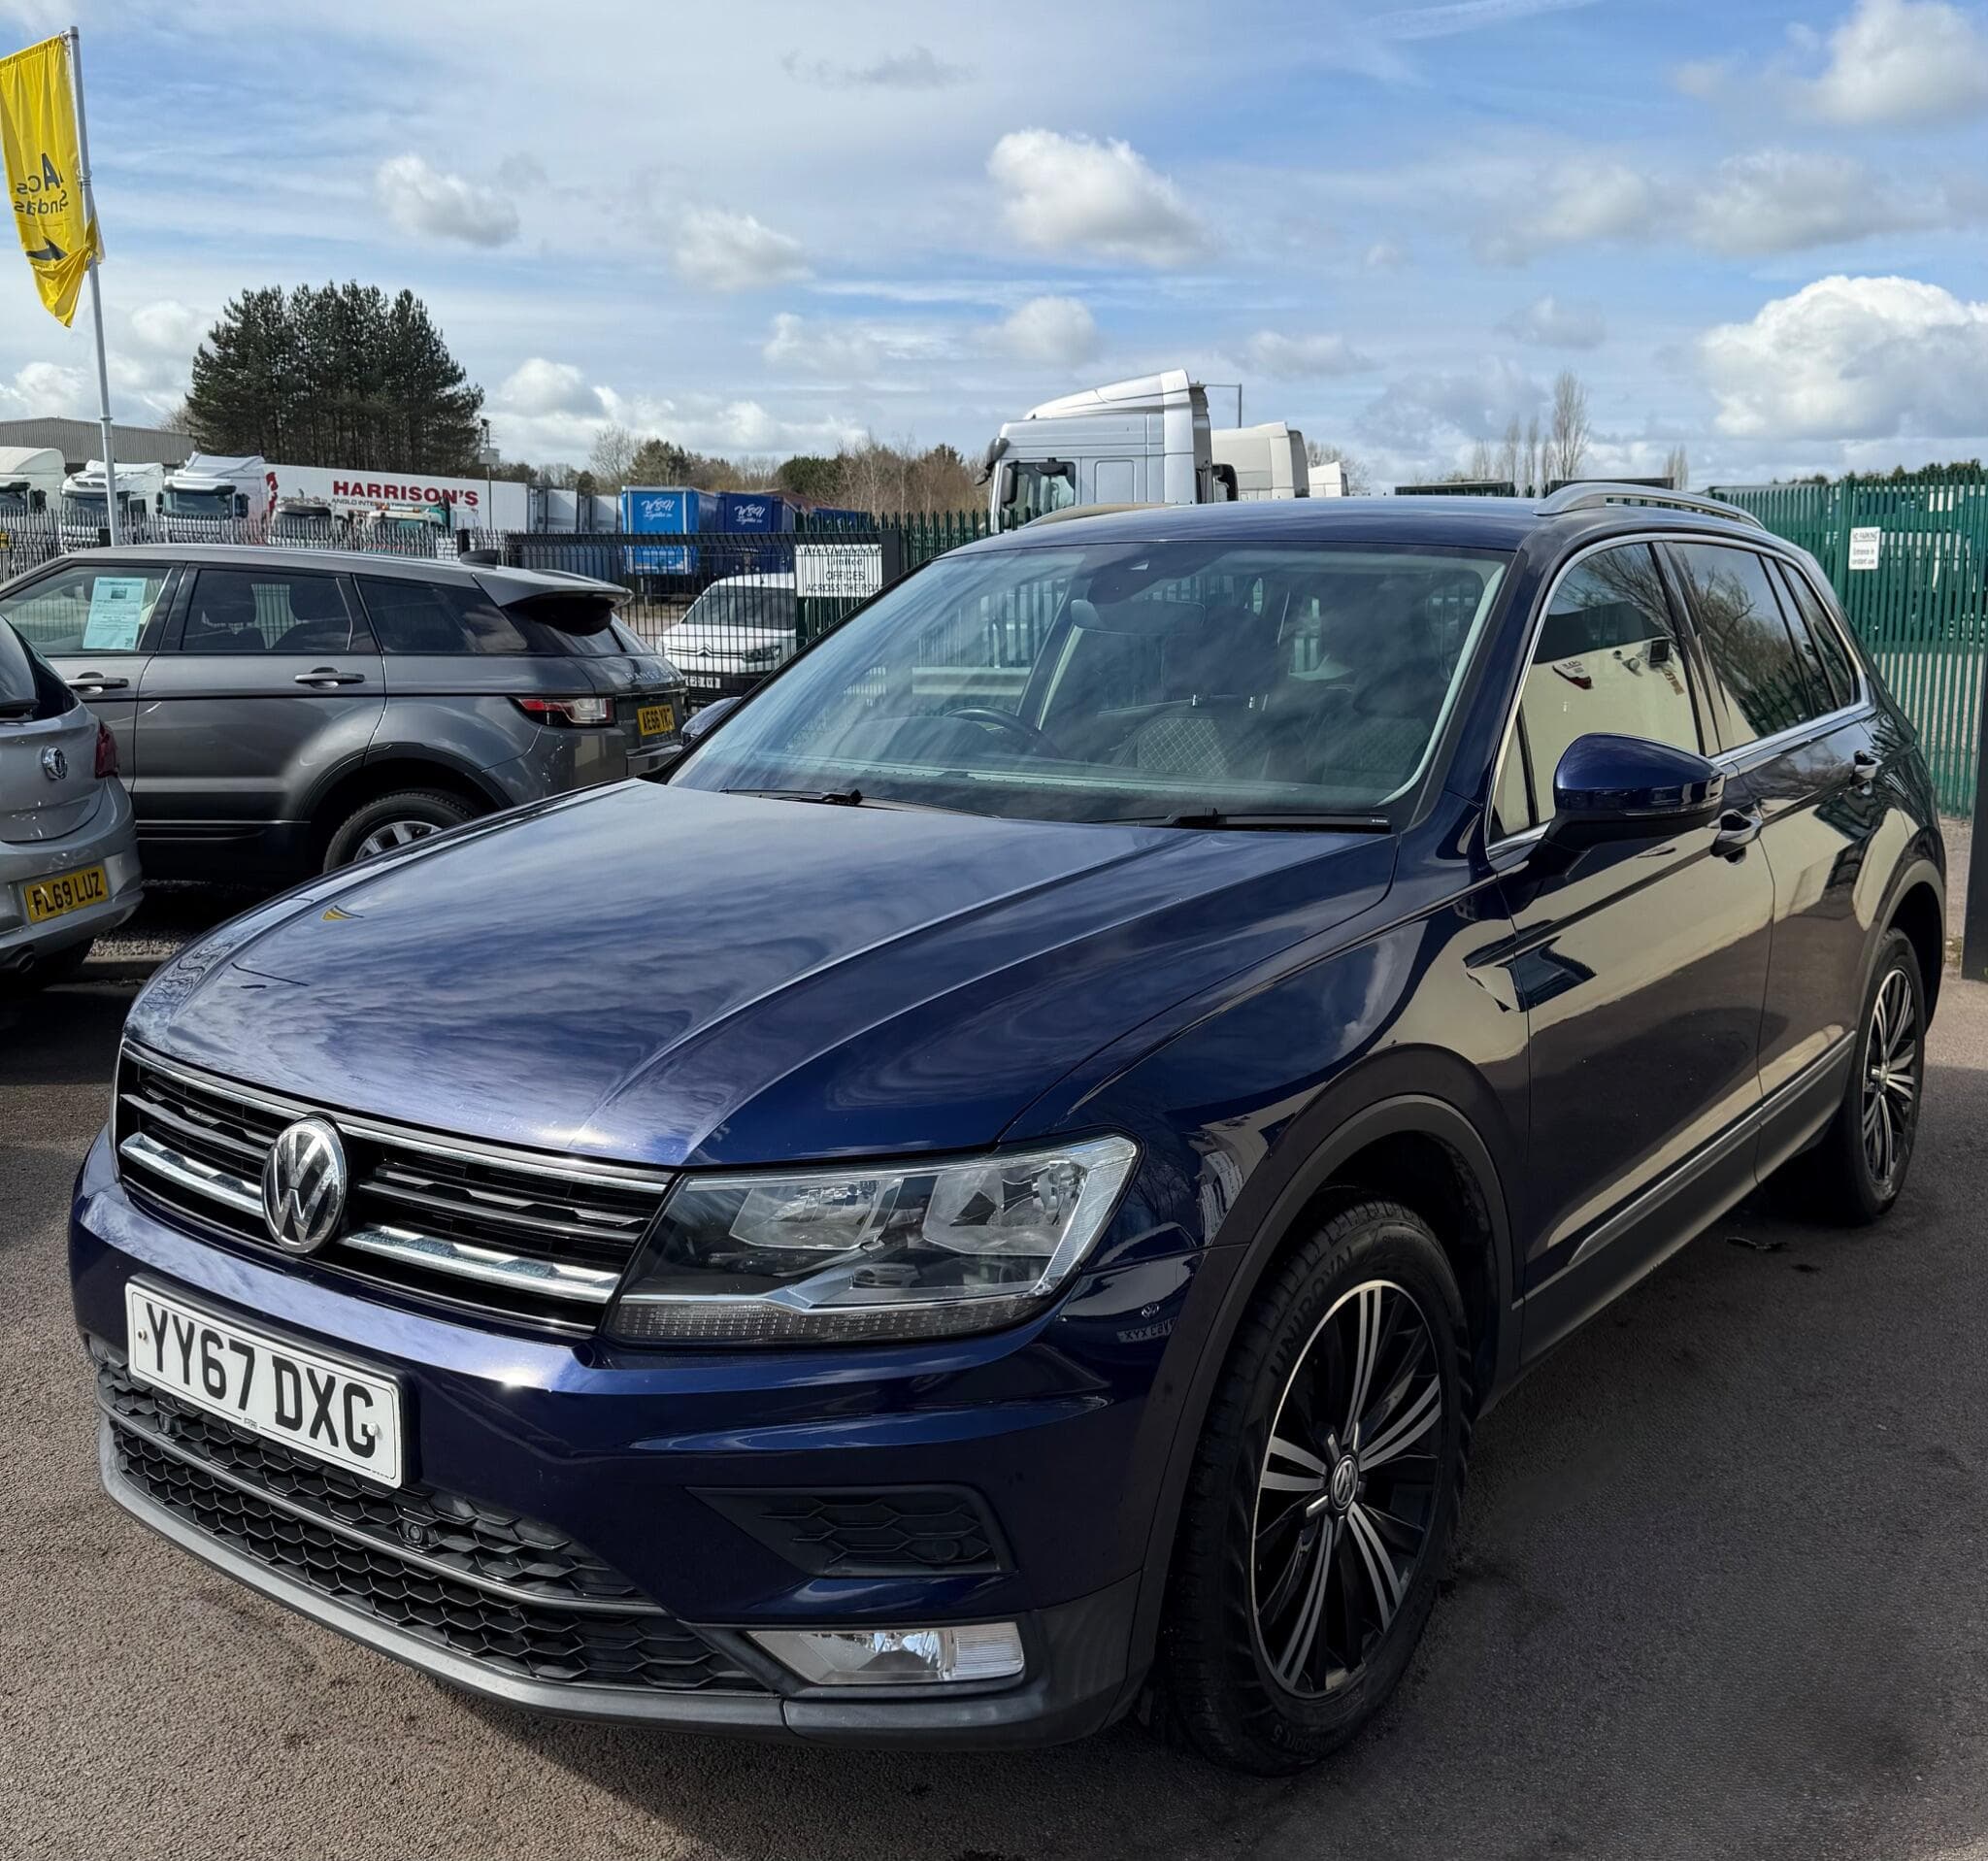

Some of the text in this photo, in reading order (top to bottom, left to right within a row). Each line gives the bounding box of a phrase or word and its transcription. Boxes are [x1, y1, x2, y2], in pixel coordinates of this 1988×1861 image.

[333, 481, 479, 506] HARRISON'S
[807, 582, 882, 592] ACROSS THE ROA
[826, 571, 865, 581] OFFICES
[32, 872, 103, 915] FL69 LUZ
[146, 1302, 377, 1459] YY67 DXG
